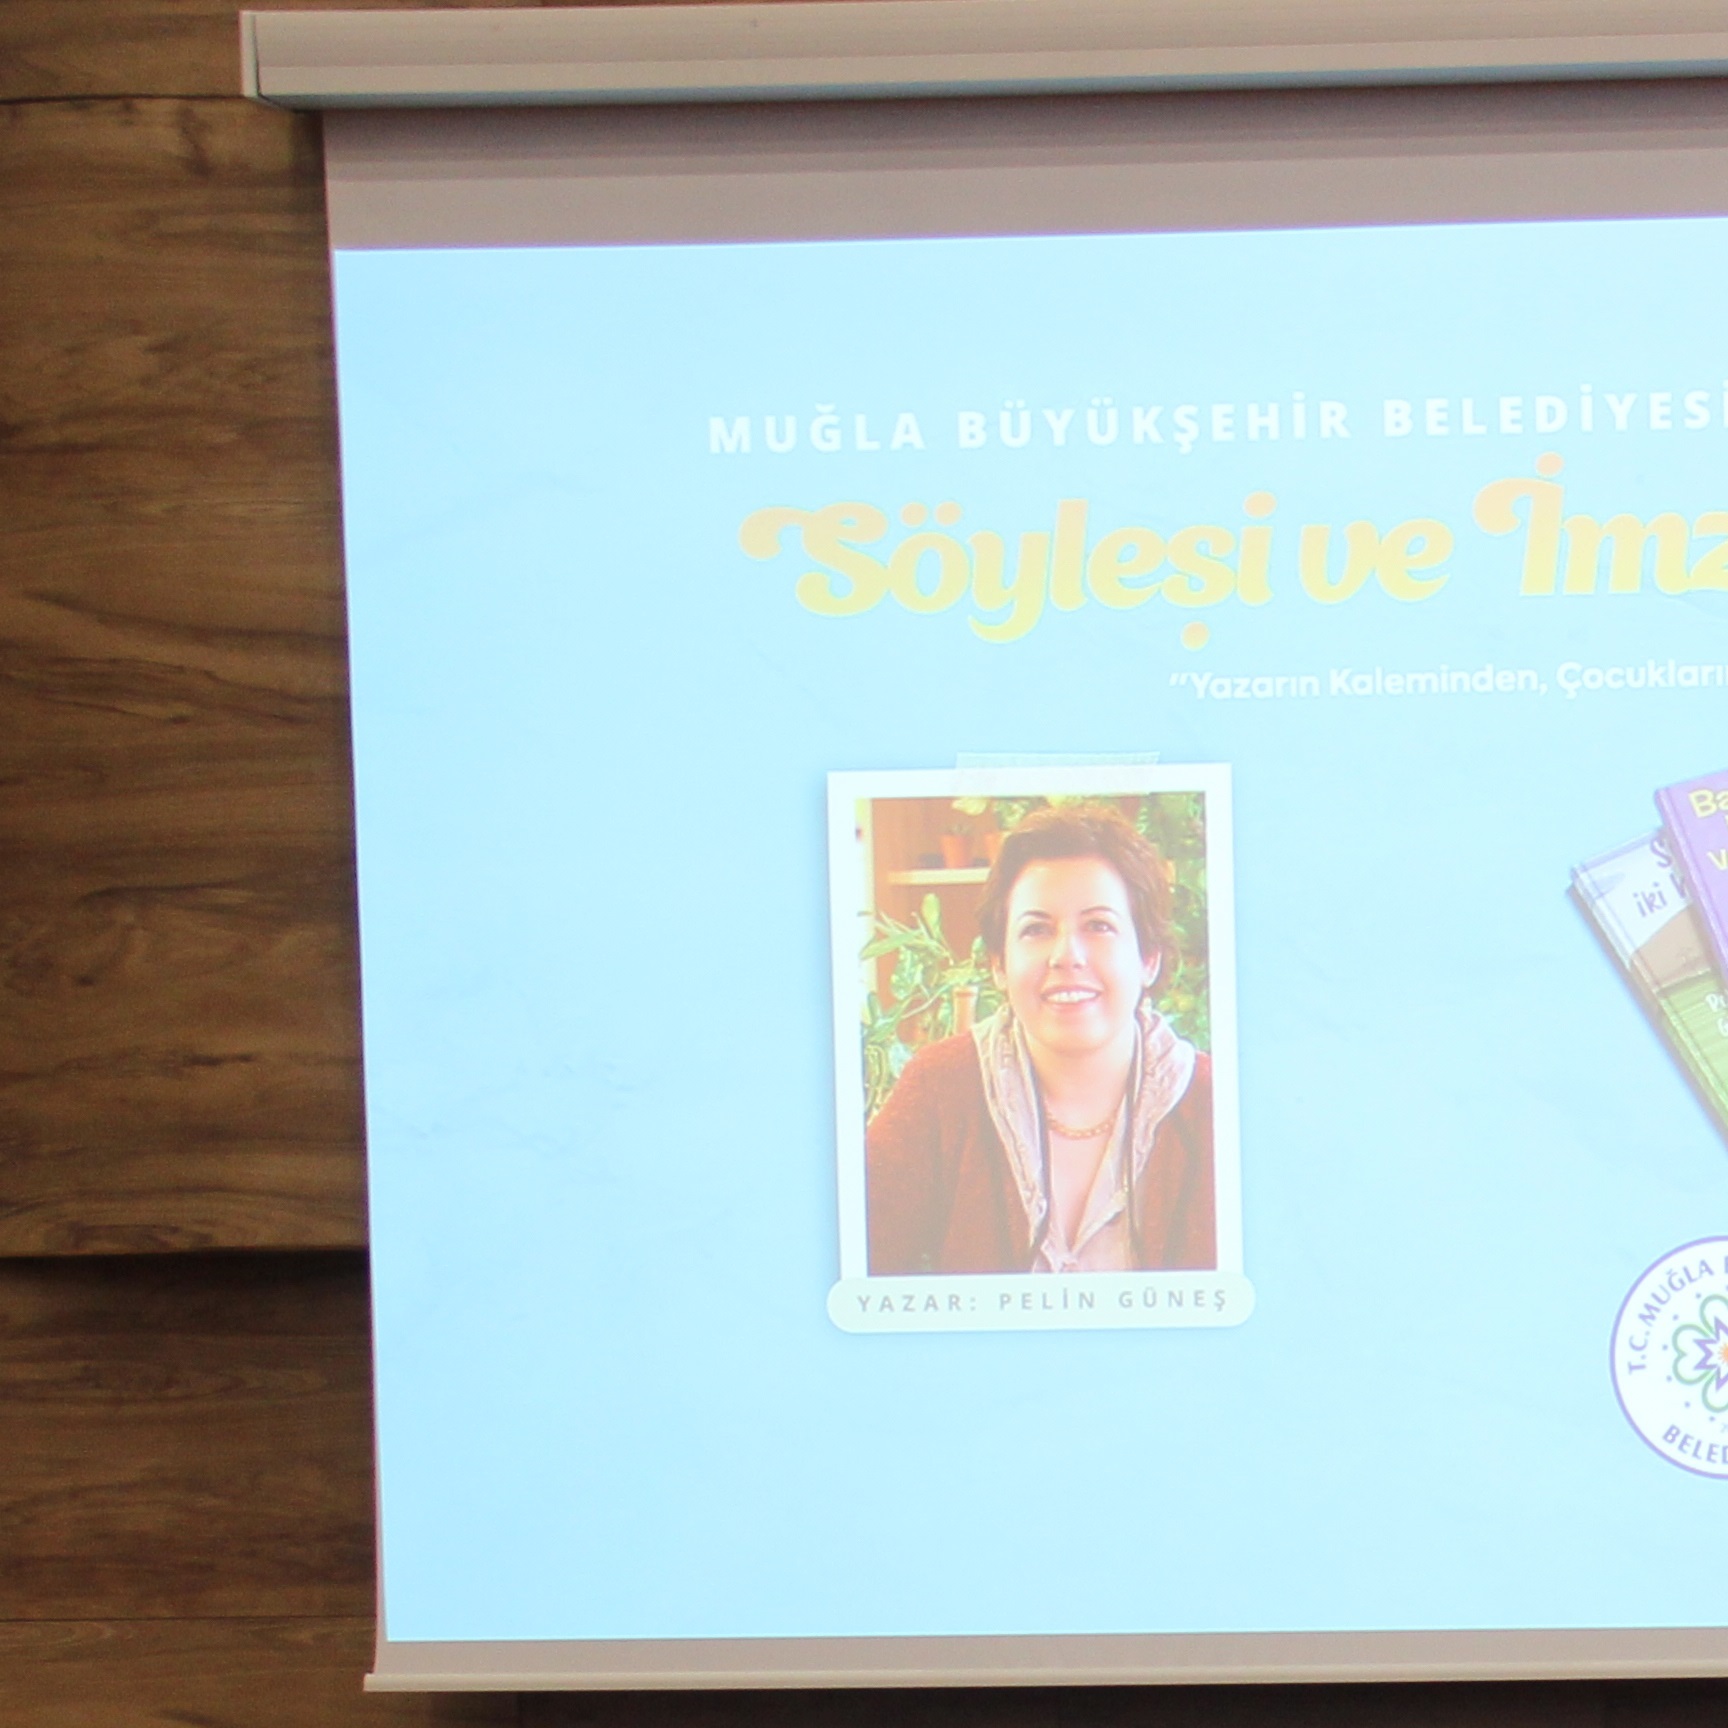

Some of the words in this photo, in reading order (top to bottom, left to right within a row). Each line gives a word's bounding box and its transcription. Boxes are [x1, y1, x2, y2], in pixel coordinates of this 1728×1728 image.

[709, 403, 926, 454] MUĞLA
[958, 392, 1352, 454] BÜYÜKŞEHİR
[739, 490, 1277, 650] Söyleşi
[1298, 518, 1454, 605] ve
[1328, 662, 1547, 698] Kaleminden,
[856, 1293, 979, 1314] YAZAR:
[998, 1287, 1097, 1312] PELİN
[1117, 1286, 1227, 1313] GÜNEŞ
[1637, 1258, 1714, 1333] MUĞLA
